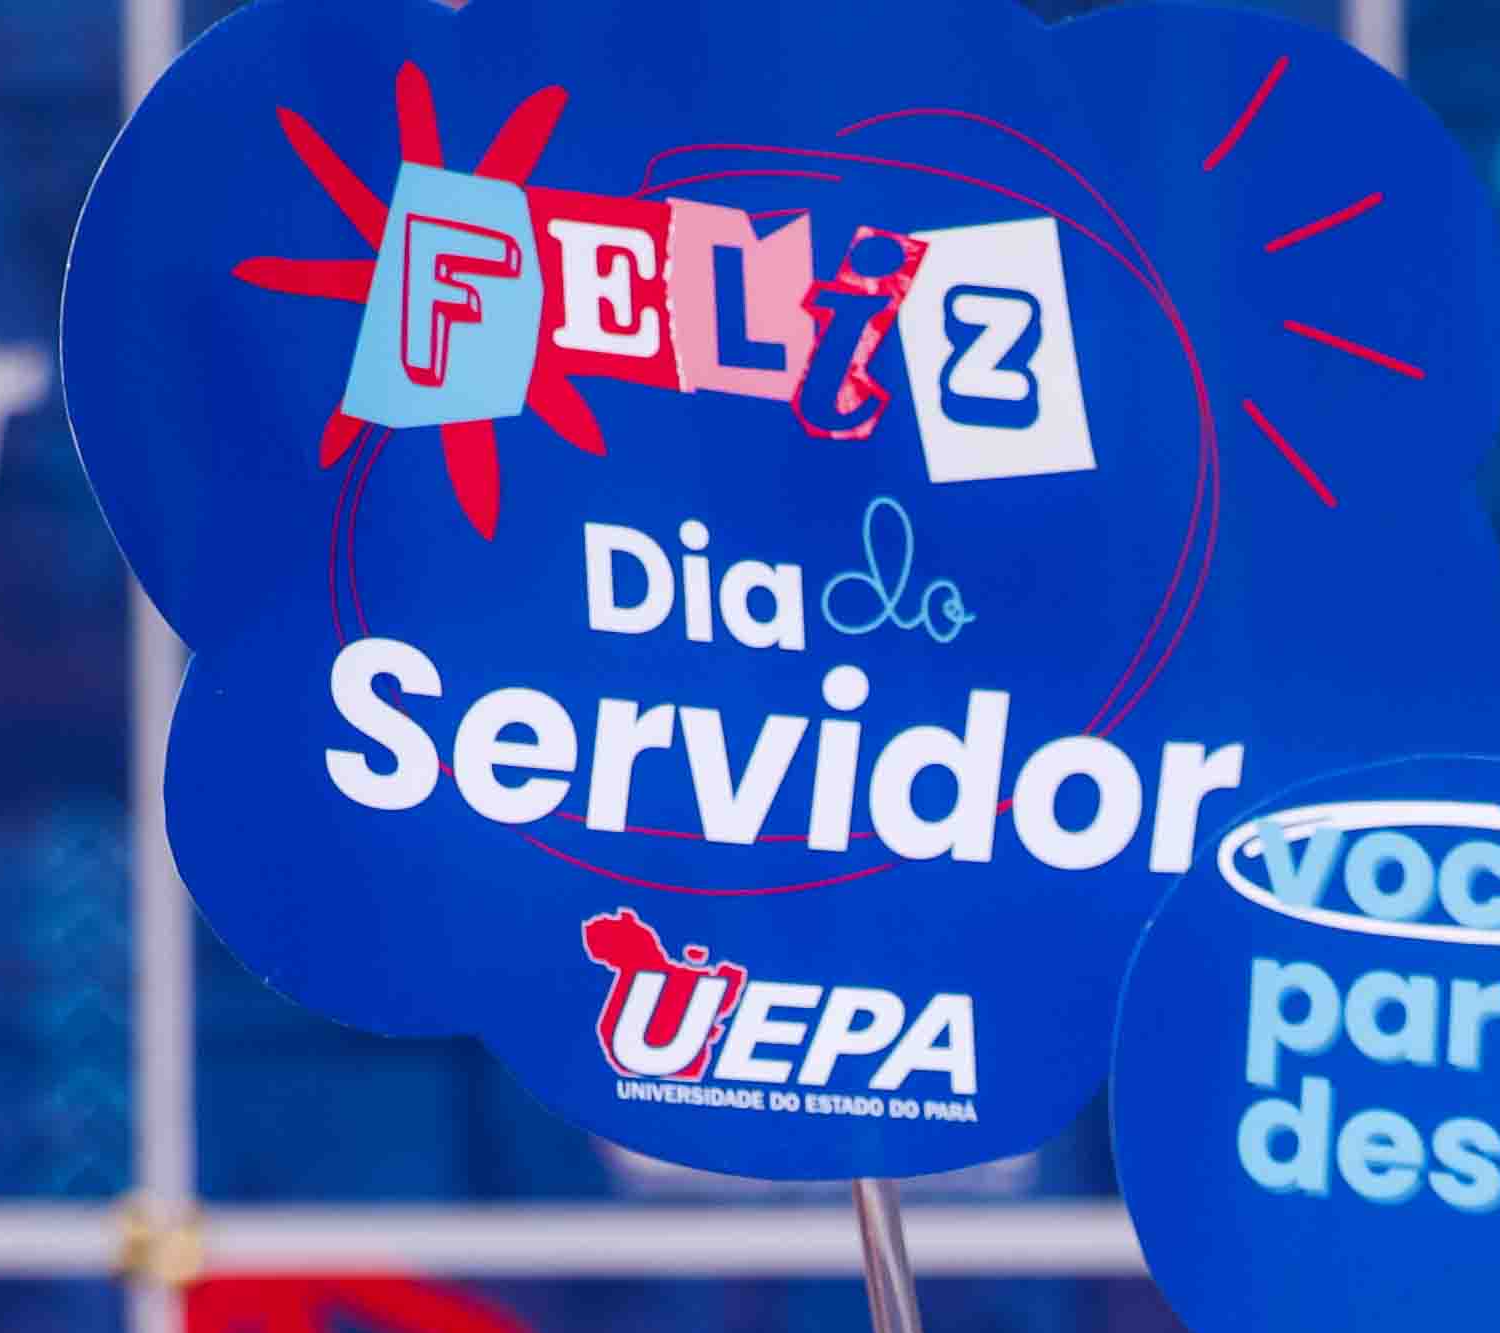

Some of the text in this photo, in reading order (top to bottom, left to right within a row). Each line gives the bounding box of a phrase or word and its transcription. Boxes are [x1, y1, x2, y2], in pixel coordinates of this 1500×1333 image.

[584, 497, 976, 652] Dia do
[324, 635, 1243, 874] Servidor
[610, 966, 978, 1097] UEPA
[616, 1079, 764, 1111] UNIVERSIDADE
[769, 1091, 800, 1113] DO
[805, 1093, 884, 1118] ESTADO
[889, 1098, 919, 1120] DO
